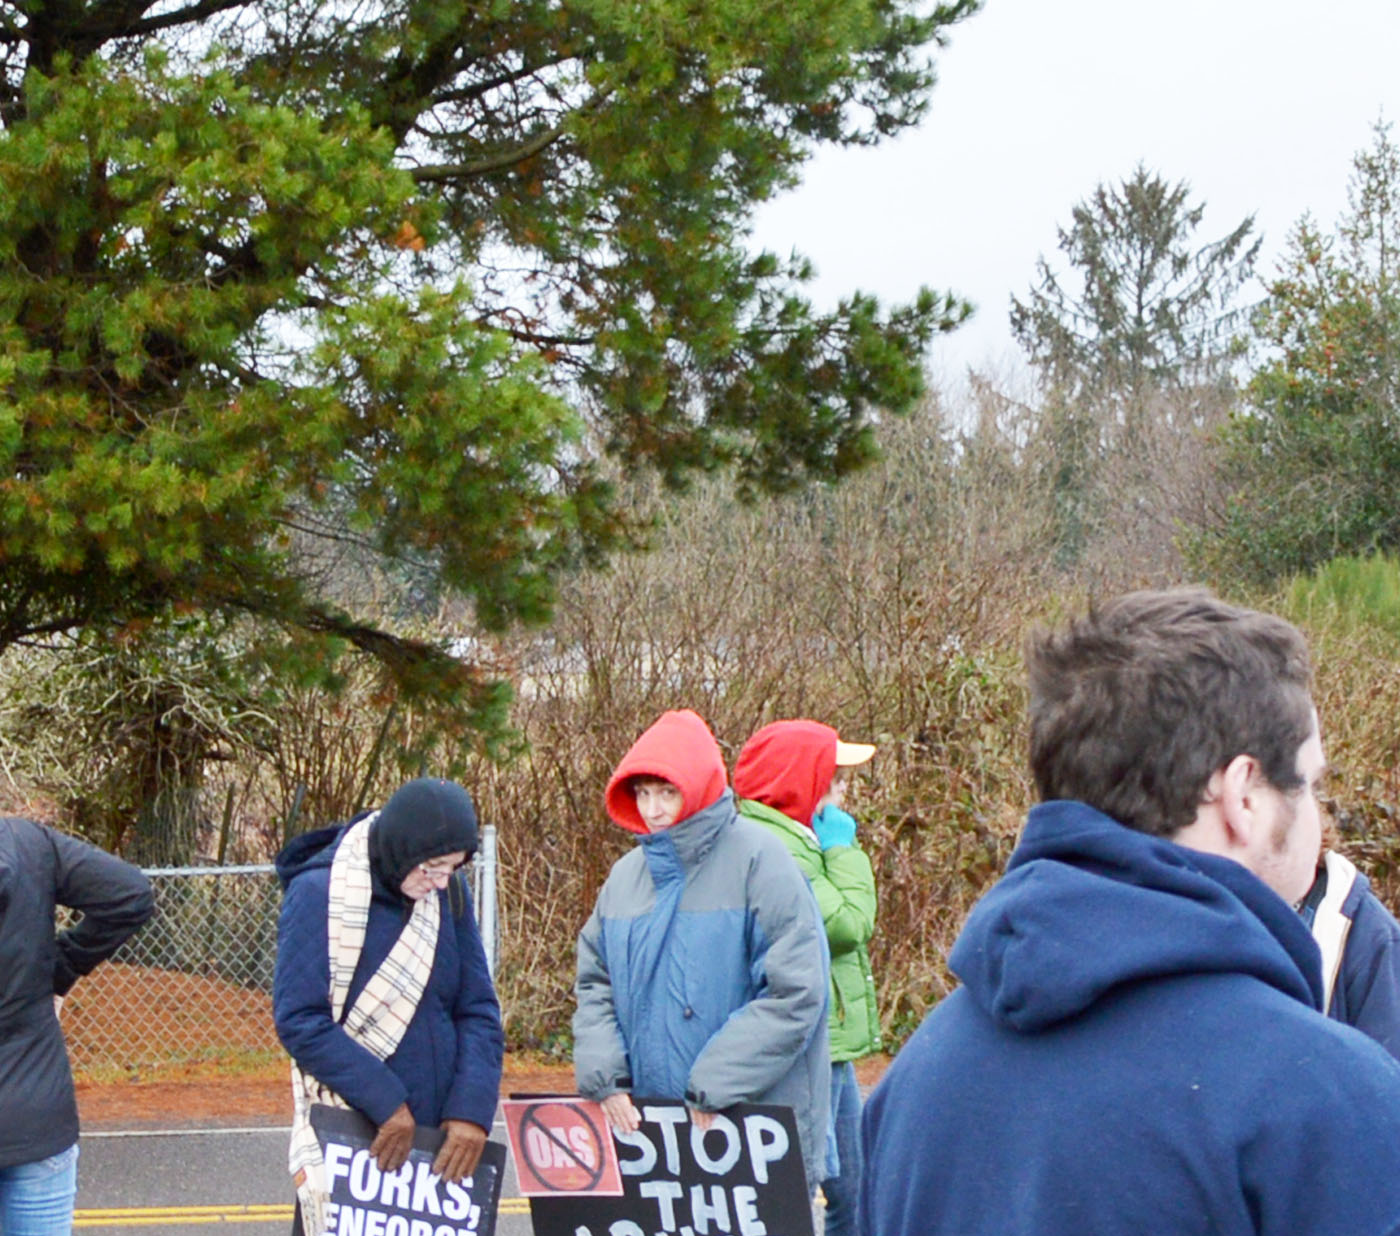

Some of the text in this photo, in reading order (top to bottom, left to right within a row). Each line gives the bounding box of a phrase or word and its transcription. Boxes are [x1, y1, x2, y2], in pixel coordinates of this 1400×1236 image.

[527, 1125, 596, 1169] OAS
[612, 1105, 789, 1184] STOP
[324, 1142, 481, 1229] FORKS,
